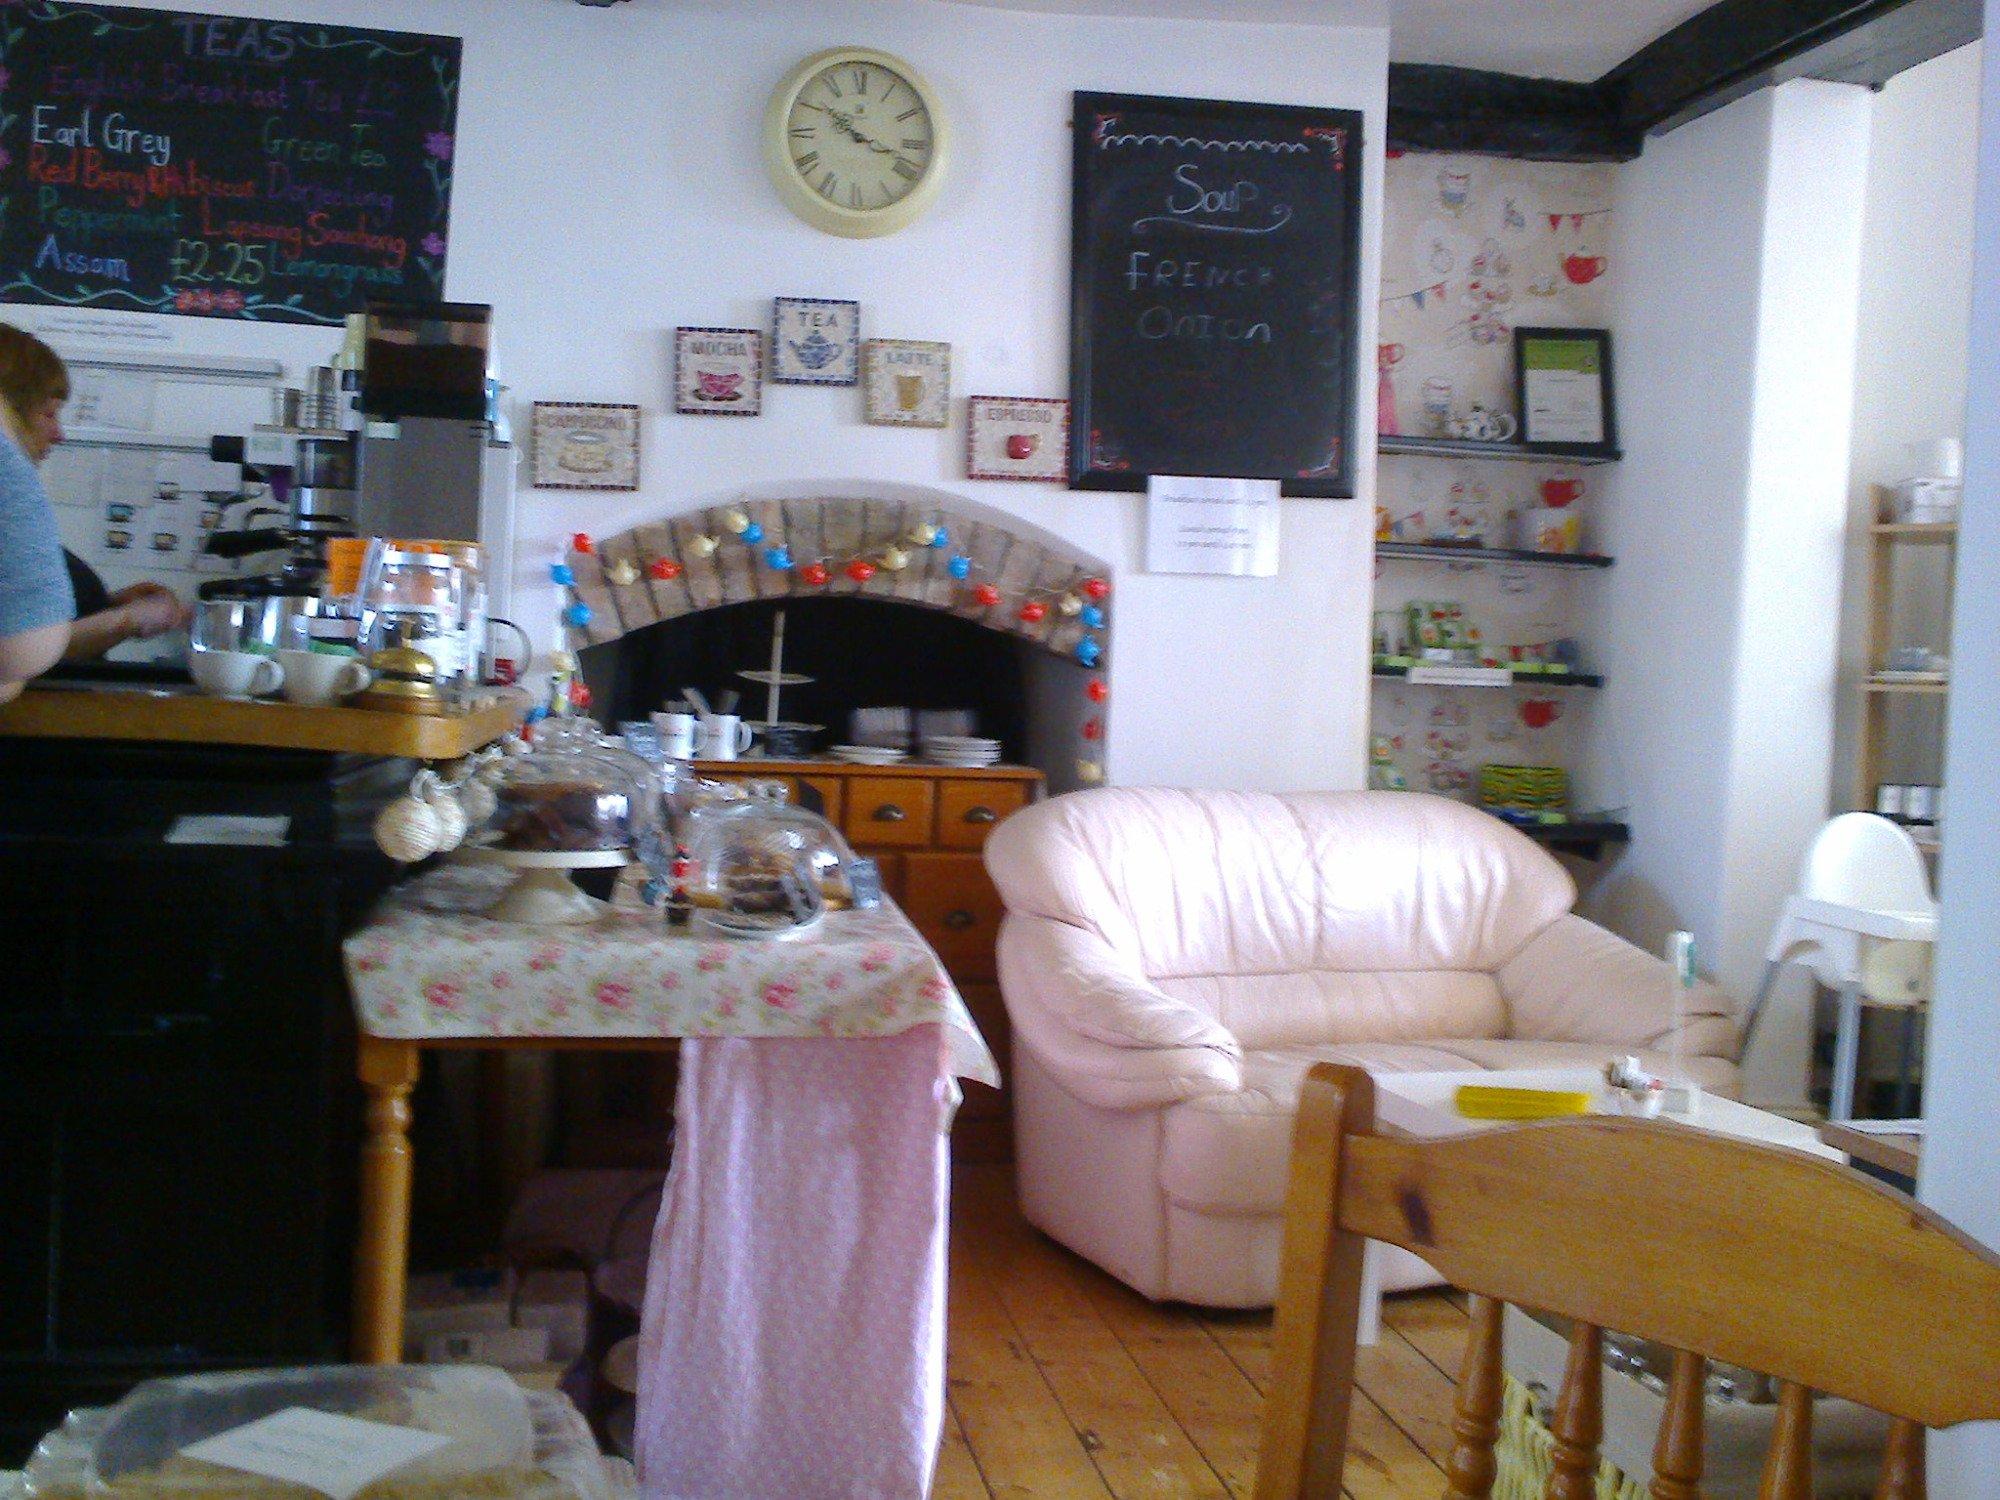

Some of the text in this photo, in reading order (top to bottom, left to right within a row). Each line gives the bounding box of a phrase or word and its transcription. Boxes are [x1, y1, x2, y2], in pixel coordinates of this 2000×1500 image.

[172, 18, 296, 61] TEAS
[31, 105, 171, 166] Earl Grey
[28, 144, 78, 184] Red
[34, 233, 131, 282] Assam
[168, 237, 267, 286] £2.25
[798, 310, 839, 328] TEA
